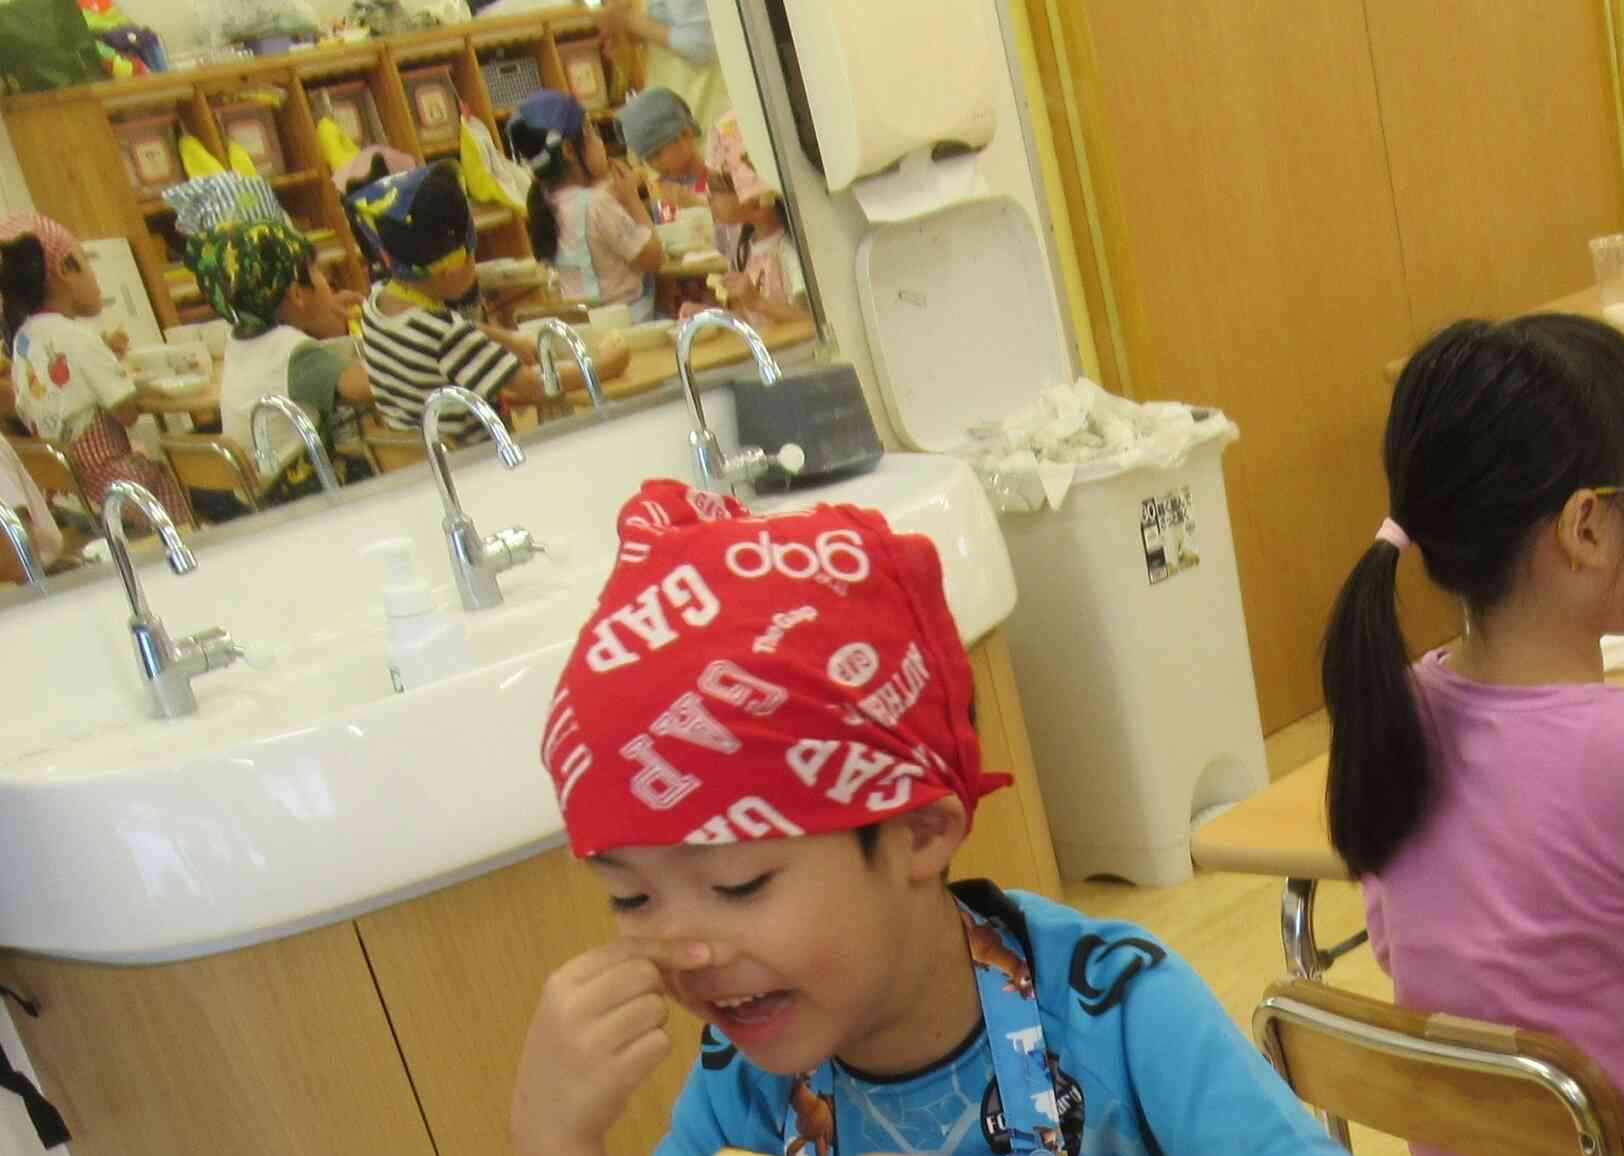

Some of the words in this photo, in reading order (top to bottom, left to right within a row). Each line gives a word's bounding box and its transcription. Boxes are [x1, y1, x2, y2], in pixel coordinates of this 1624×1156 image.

[725, 529, 870, 583] gap
[585, 563, 721, 674] GAP
[619, 659, 790, 811] GAP
